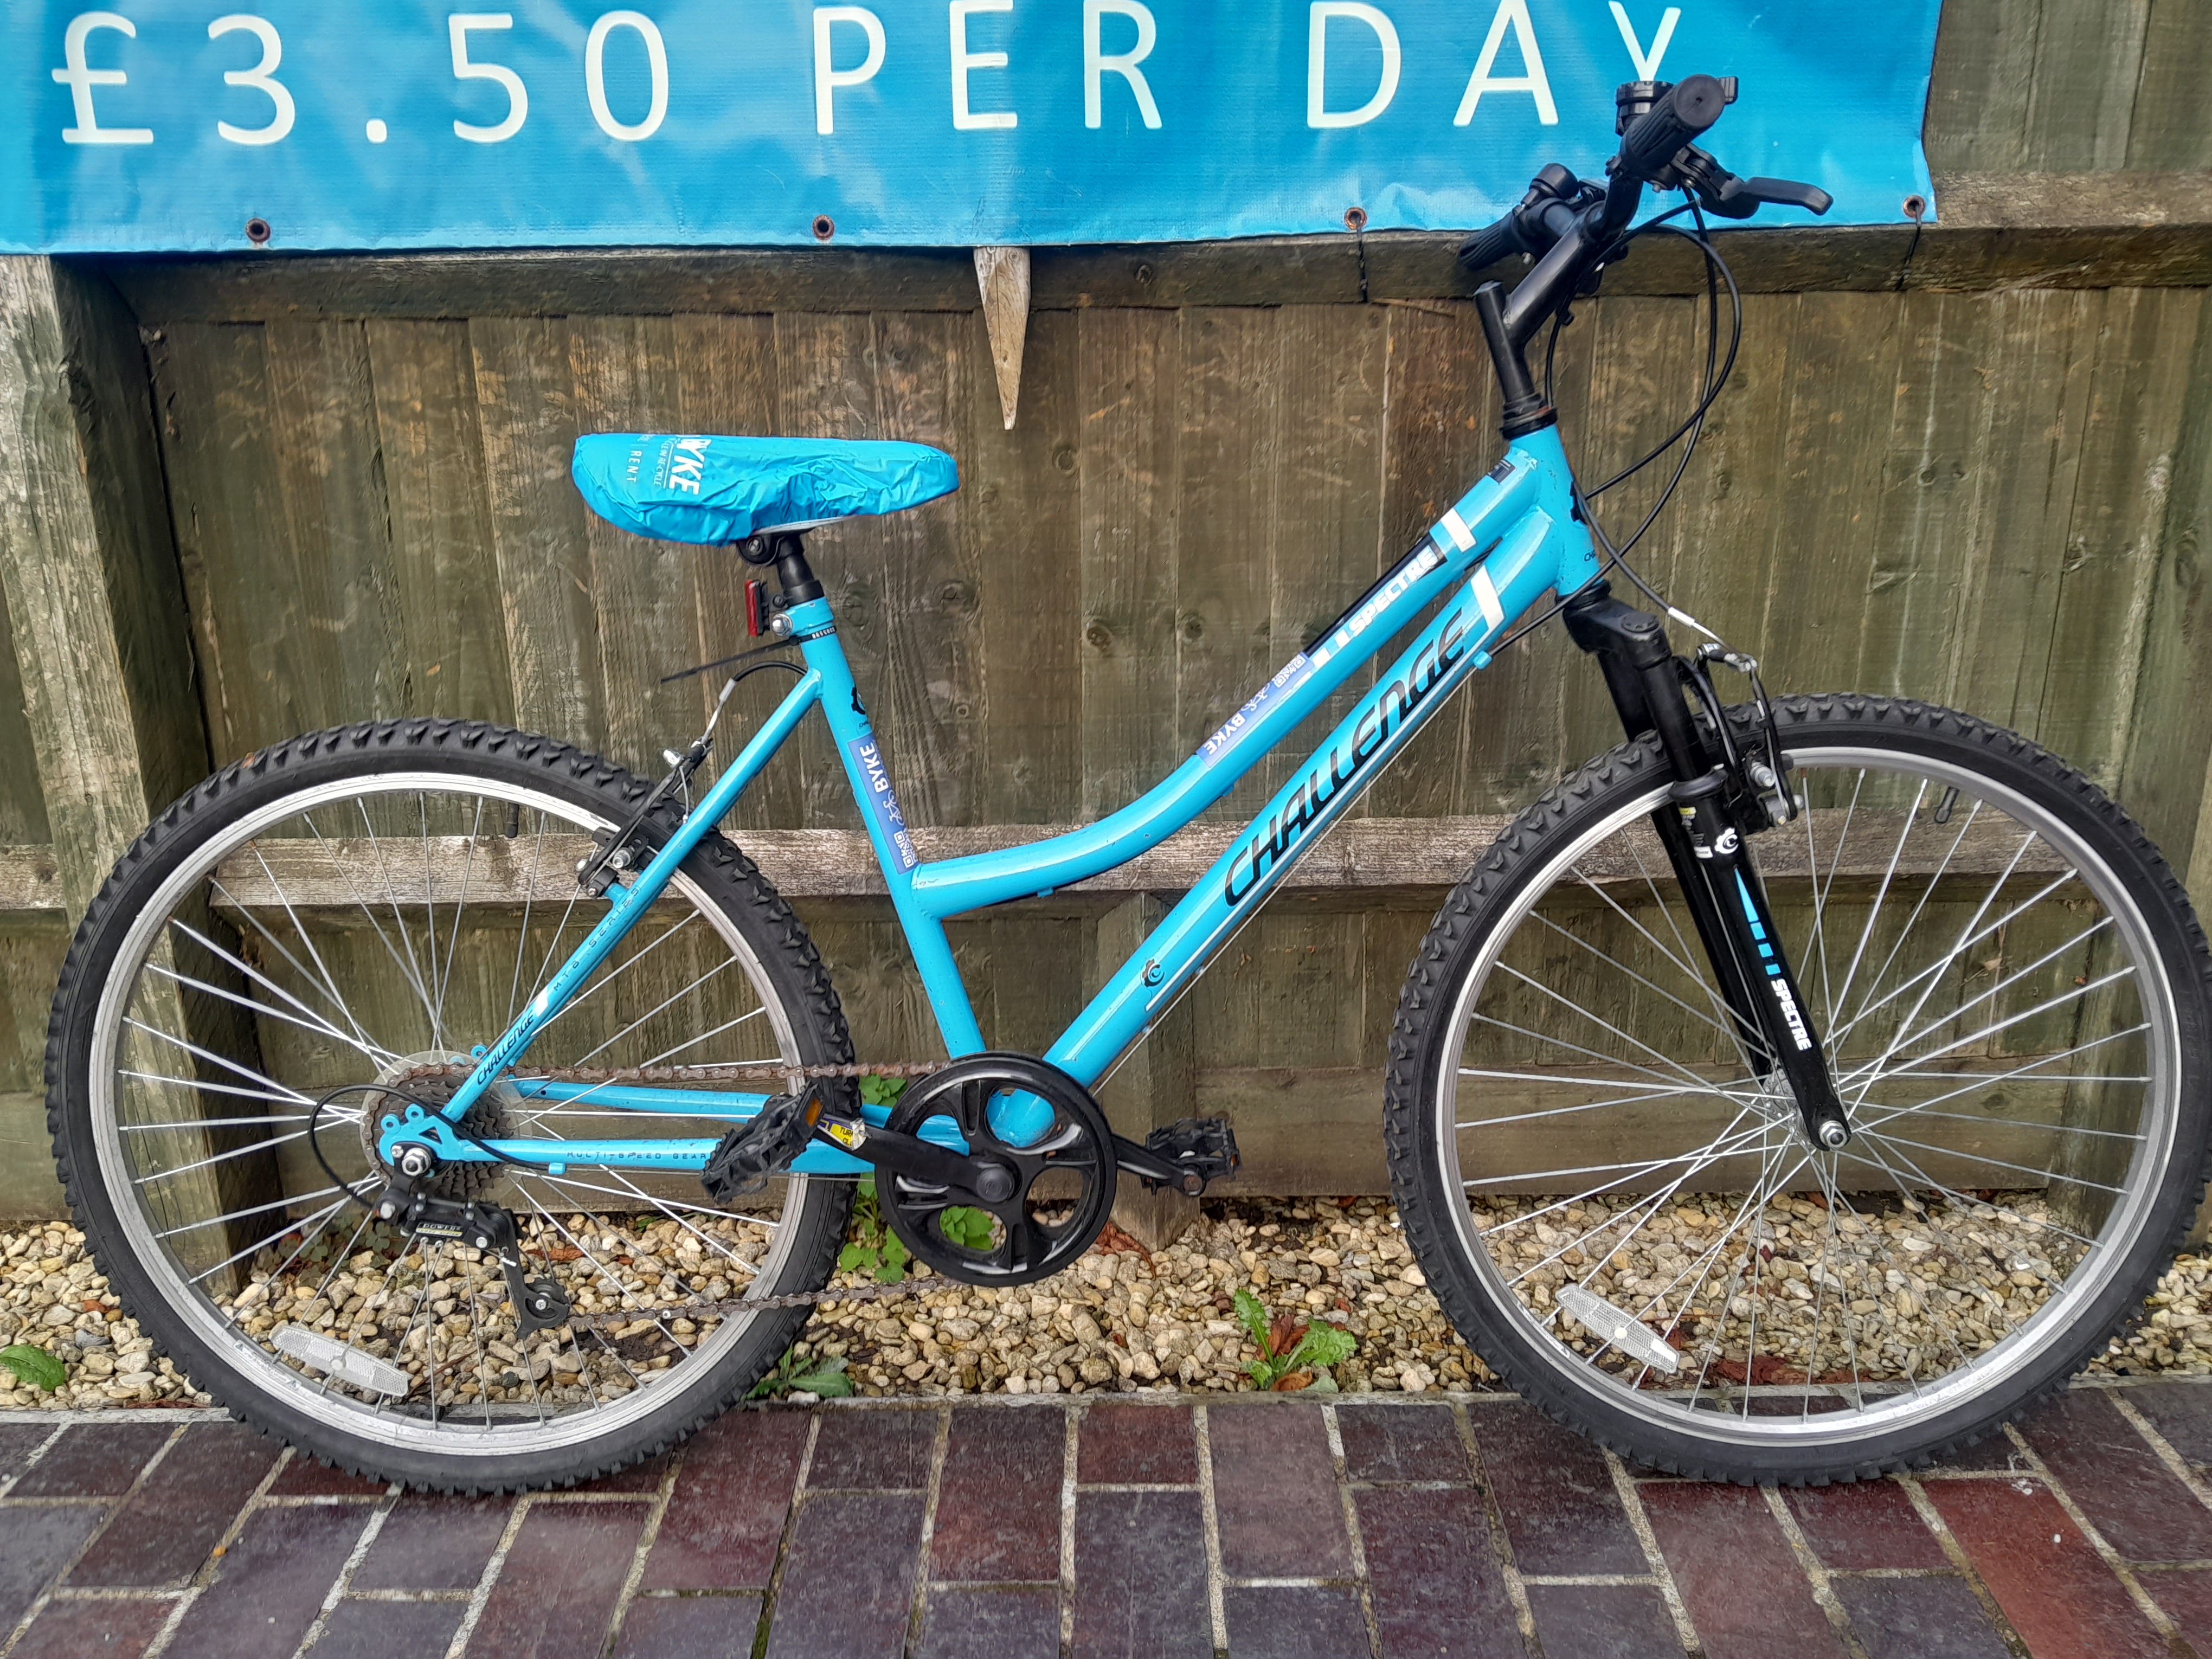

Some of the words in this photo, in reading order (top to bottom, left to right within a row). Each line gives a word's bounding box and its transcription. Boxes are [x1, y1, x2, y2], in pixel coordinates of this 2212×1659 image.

[50, 9, 671, 145] £3.50
[812, 0, 1163, 136] PER
[1306, 0, 1681, 129] DAY
[626, 449, 643, 484] RENT
[1348, 544, 1439, 637] SPECTRE
[1203, 712, 1246, 756] BYKE
[1224, 607, 1465, 907] CHALLENGE
[859, 741, 890, 793] BYKE
[553, 960, 580, 991] MTB
[1771, 978, 1812, 1051] SPECTRE
[477, 1009, 534, 1085] CHALLENGE
[567, 1151, 661, 1160] MULTI-SPEED
